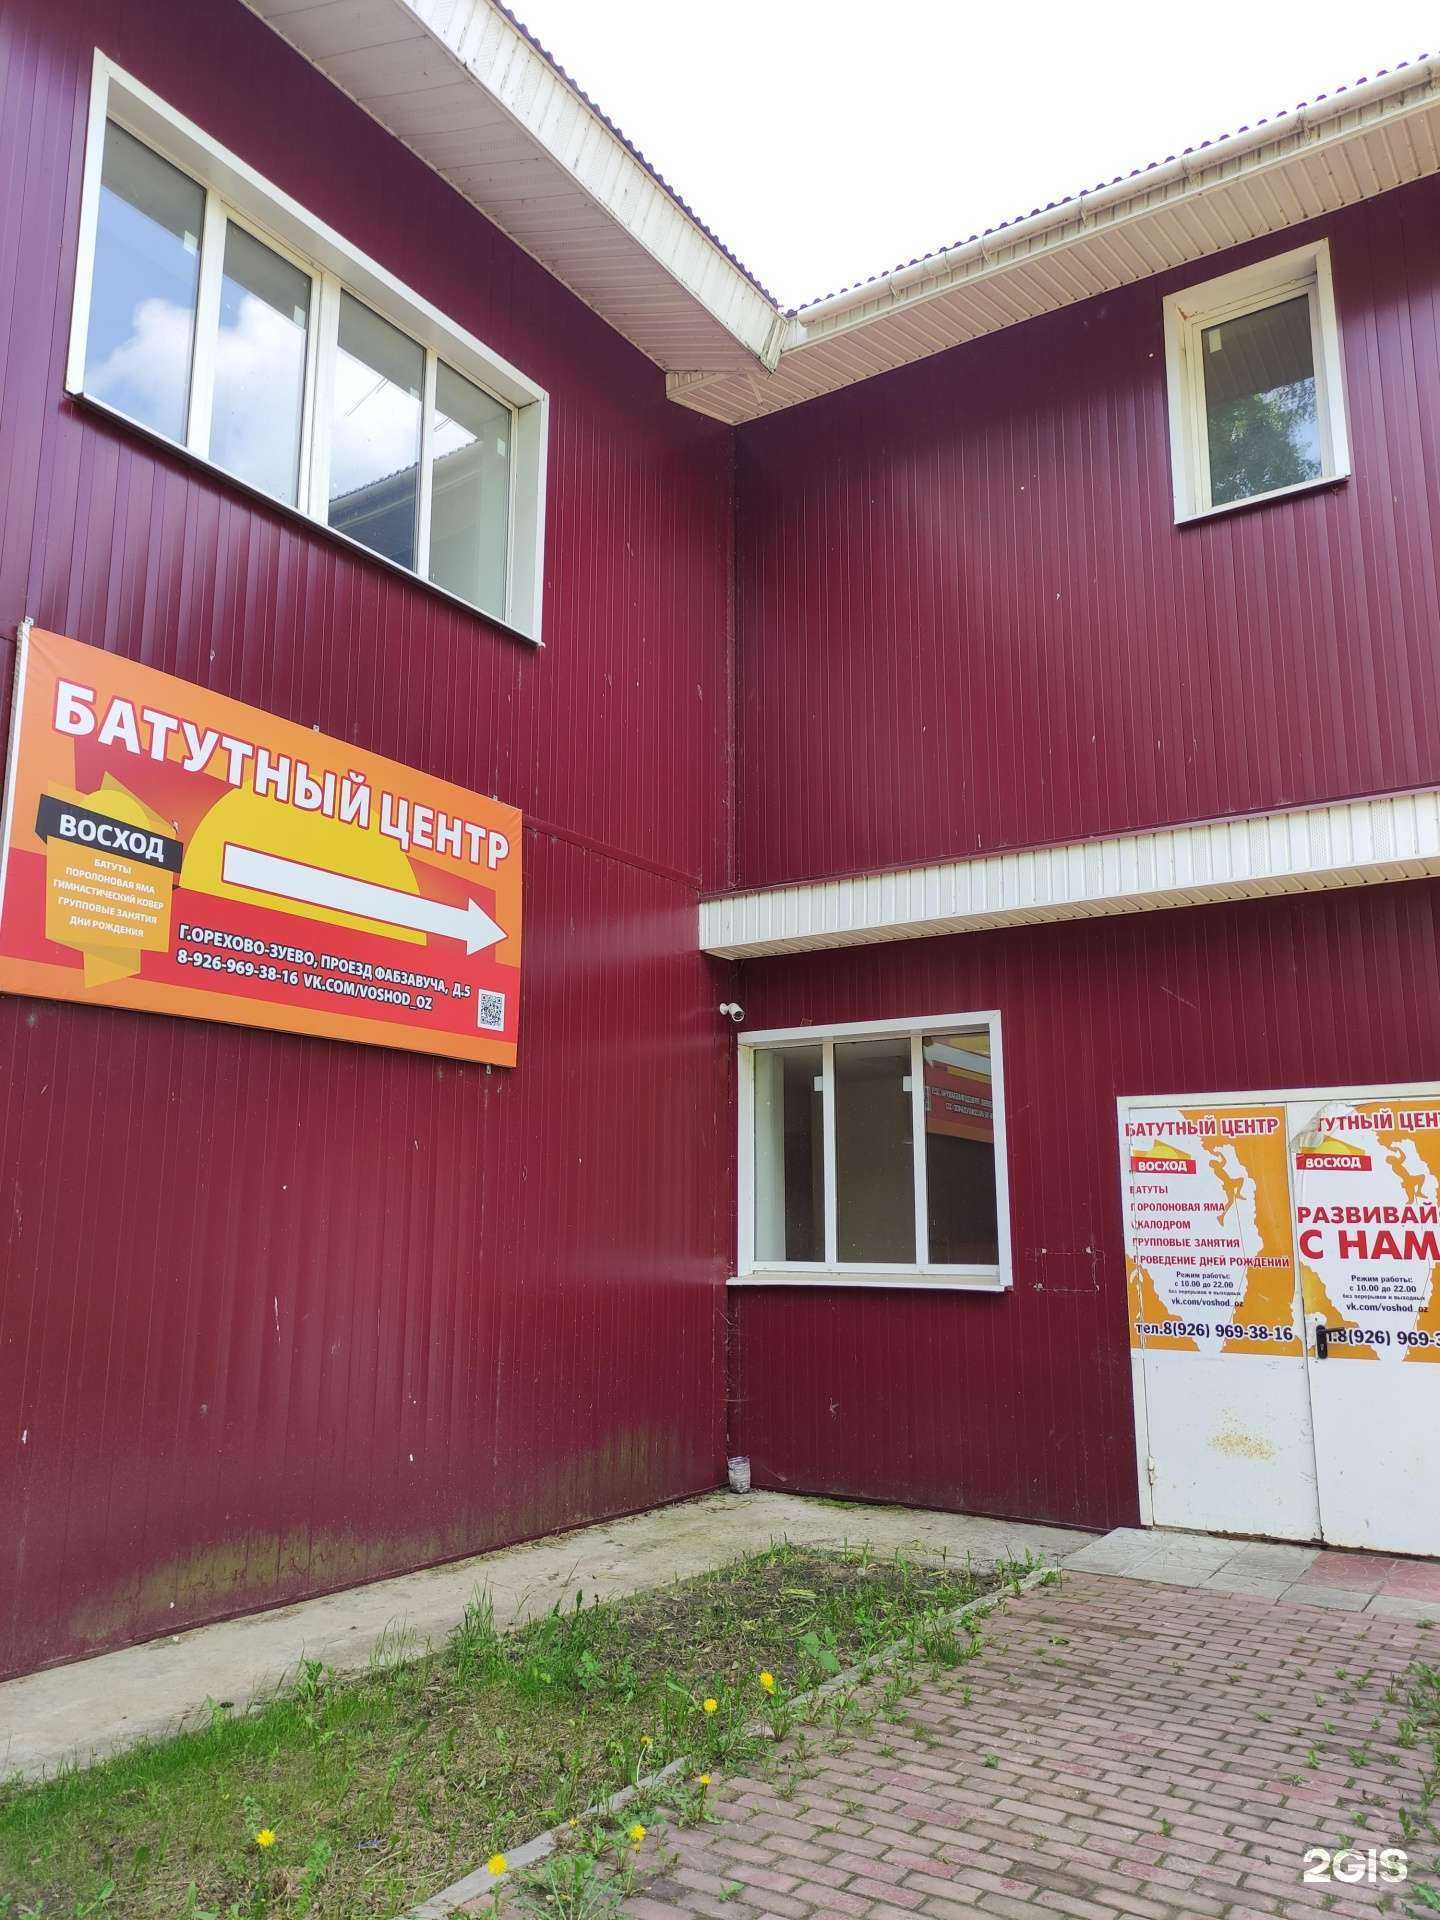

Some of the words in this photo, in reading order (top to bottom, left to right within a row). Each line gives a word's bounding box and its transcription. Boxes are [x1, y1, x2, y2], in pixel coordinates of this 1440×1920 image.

[53, 679, 371, 829] БАТУТНЫЙ
[379, 791, 509, 870] ЦЕНТР
[59, 814, 164, 862] ВОСХОД
[94, 859, 132, 874] БАТУТЫ
[66, 867, 134, 889] ПОРОЛОНОВАЯ
[135, 884, 155, 894] ЯМА
[53, 879, 136, 904] ГИМНАСТИЧЕСКИЙ
[136, 897, 164, 910] КОВЕР
[58, 896, 115, 915] ГРУППОВЫЕ
[116, 910, 158, 924] ЗАНЯТИЯ
[69, 916, 91, 927] ДНИ
[92, 918, 144, 937] РОЖДЕНИЯ
[179, 923, 318, 968] Г.ОРЕХОВО-ЗУЕВО,
[320, 954, 373, 981] ПРОЕЗД
[374, 966, 449, 995] ФАБЗАВУЧА,
[452, 982, 472, 999] Д.5
[177, 949, 299, 985] 8-926-969-38-16
[303, 973, 432, 1010] VK.COM/VOSHOD_OZ
[1125, 1114, 1216, 1137] БАТУТНЫЙ
[1221, 1118, 1279, 1137] ЦЕНТР
[1400, 1111, 1440, 1131] ЦЕН
[1138, 1160, 1188, 1172] ВОСХОД
[1305, 1156, 1362, 1169] ВОСХОД
[1204, 1202, 1225, 1212] ЯМА
[1297, 1202, 1440, 1224] РАЗВИВАЙ
[1194, 1238, 1240, 1248] ЗАНЯТИЯ
[1299, 1229, 1324, 1260] С
[1199, 1255, 1226, 1267] ДНЕЙ
[1176, 1271, 1200, 1279] Режим
[1181, 1280, 1201, 1288] 10.00
[1213, 1281, 1234, 1289] 22.00
[1356, 1284, 1379, 1293] 10.00
[1382, 1286, 1391, 1294] до
[1393, 1285, 1417, 1293] 22.00
[1171, 1297, 1244, 1307] vk.com/voshod_oz
[1346, 1302, 1429, 1313] vk.com/voshod_oz
[1136, 1322, 1210, 1338] тел.8(926)
[1215, 1324, 1293, 1341] 969-38-16
